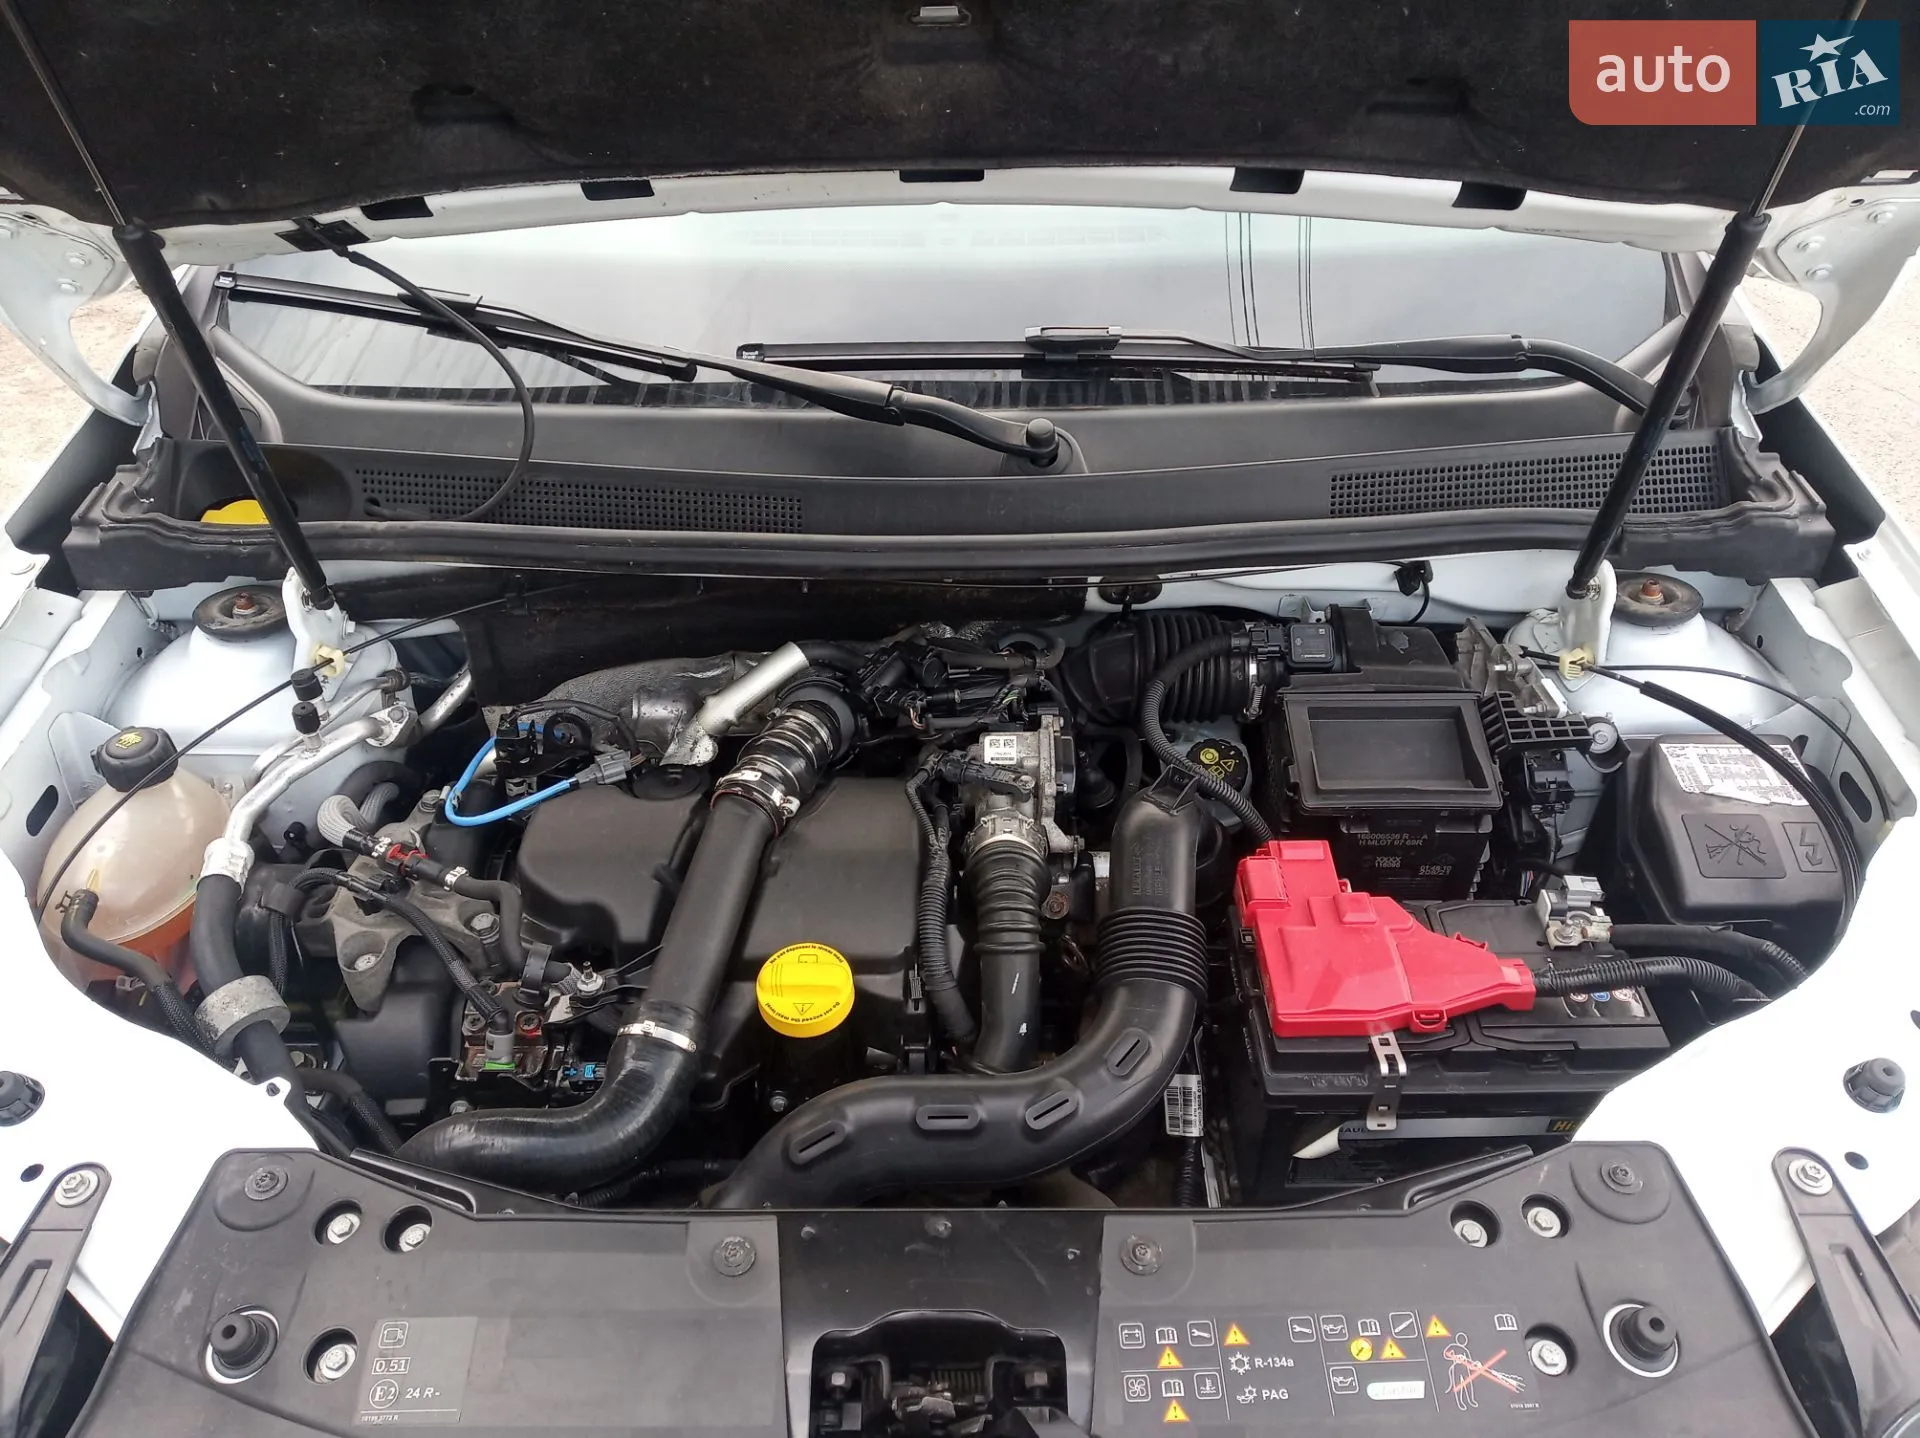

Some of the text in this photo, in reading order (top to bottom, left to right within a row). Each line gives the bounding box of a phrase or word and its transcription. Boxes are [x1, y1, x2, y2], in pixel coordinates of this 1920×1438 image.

[375, 1359, 406, 1373] 0,51
[1254, 1356, 1294, 1369] R-134a
[373, 1385, 396, 1402] E2
[405, 1387, 421, 1399] 24
[1262, 1387, 1289, 1401] PAG
